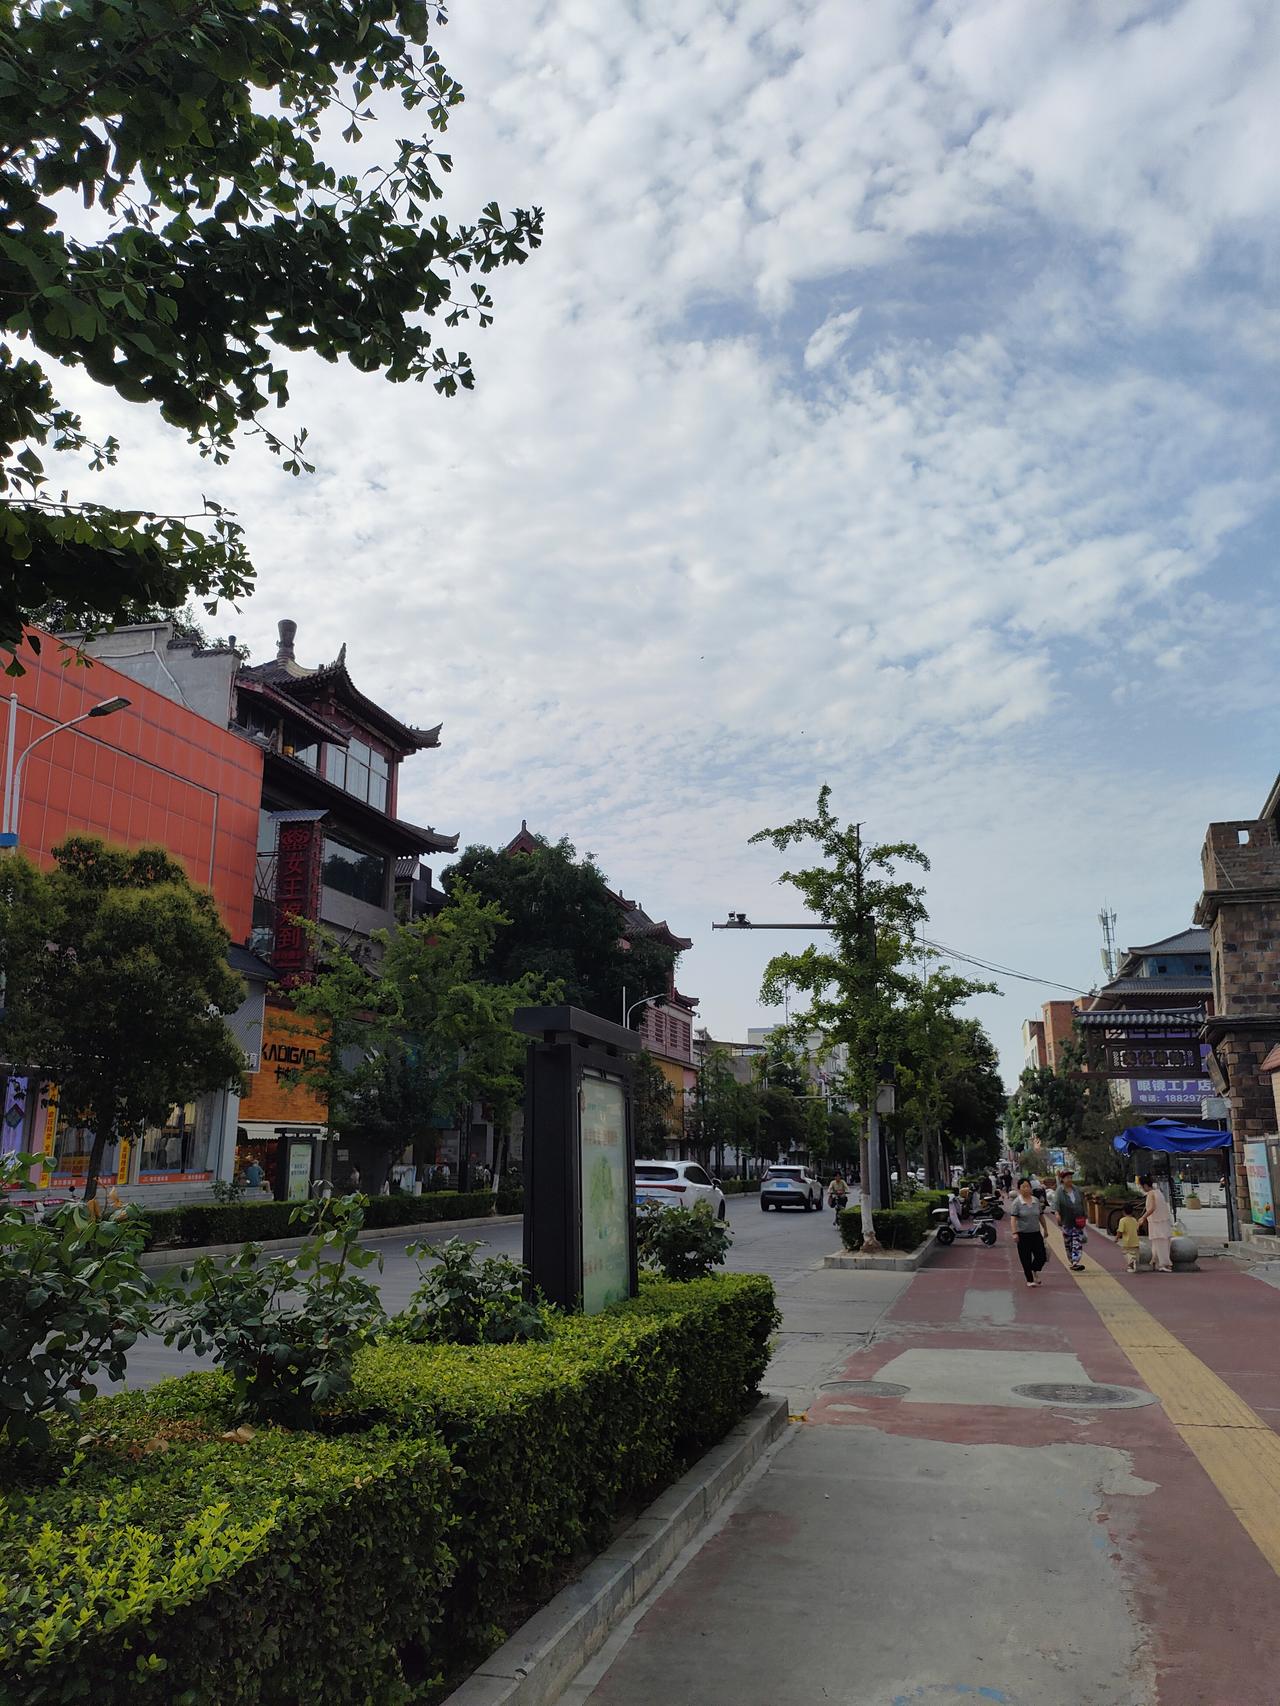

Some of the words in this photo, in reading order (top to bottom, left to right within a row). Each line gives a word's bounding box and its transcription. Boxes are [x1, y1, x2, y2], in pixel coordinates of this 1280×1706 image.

[1136, 1079, 1215, 1091] 眼镜工厂店
